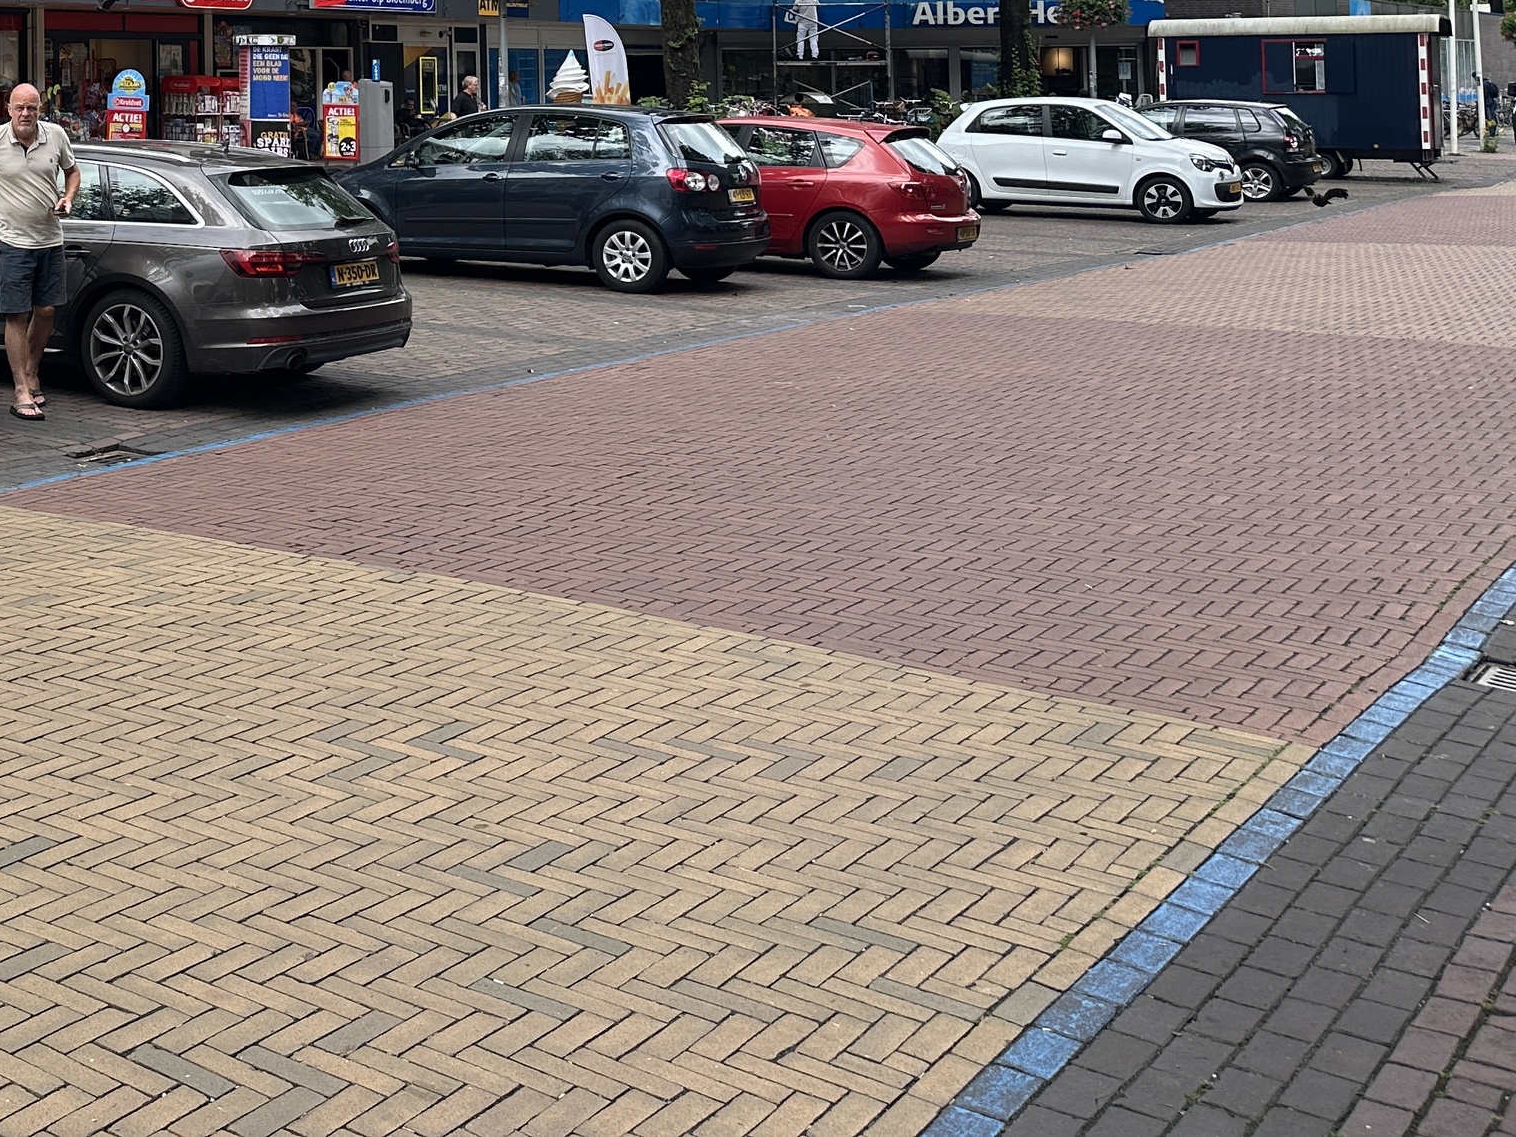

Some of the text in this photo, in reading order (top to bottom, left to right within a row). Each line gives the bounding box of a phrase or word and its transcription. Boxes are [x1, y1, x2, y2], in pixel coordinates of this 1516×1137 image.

[912, 0, 1000, 26] Alber
[327, 107, 356, 116] ACTIE!
[112, 112, 143, 123] ACTIE!
[340, 140, 357, 152] 2+3
